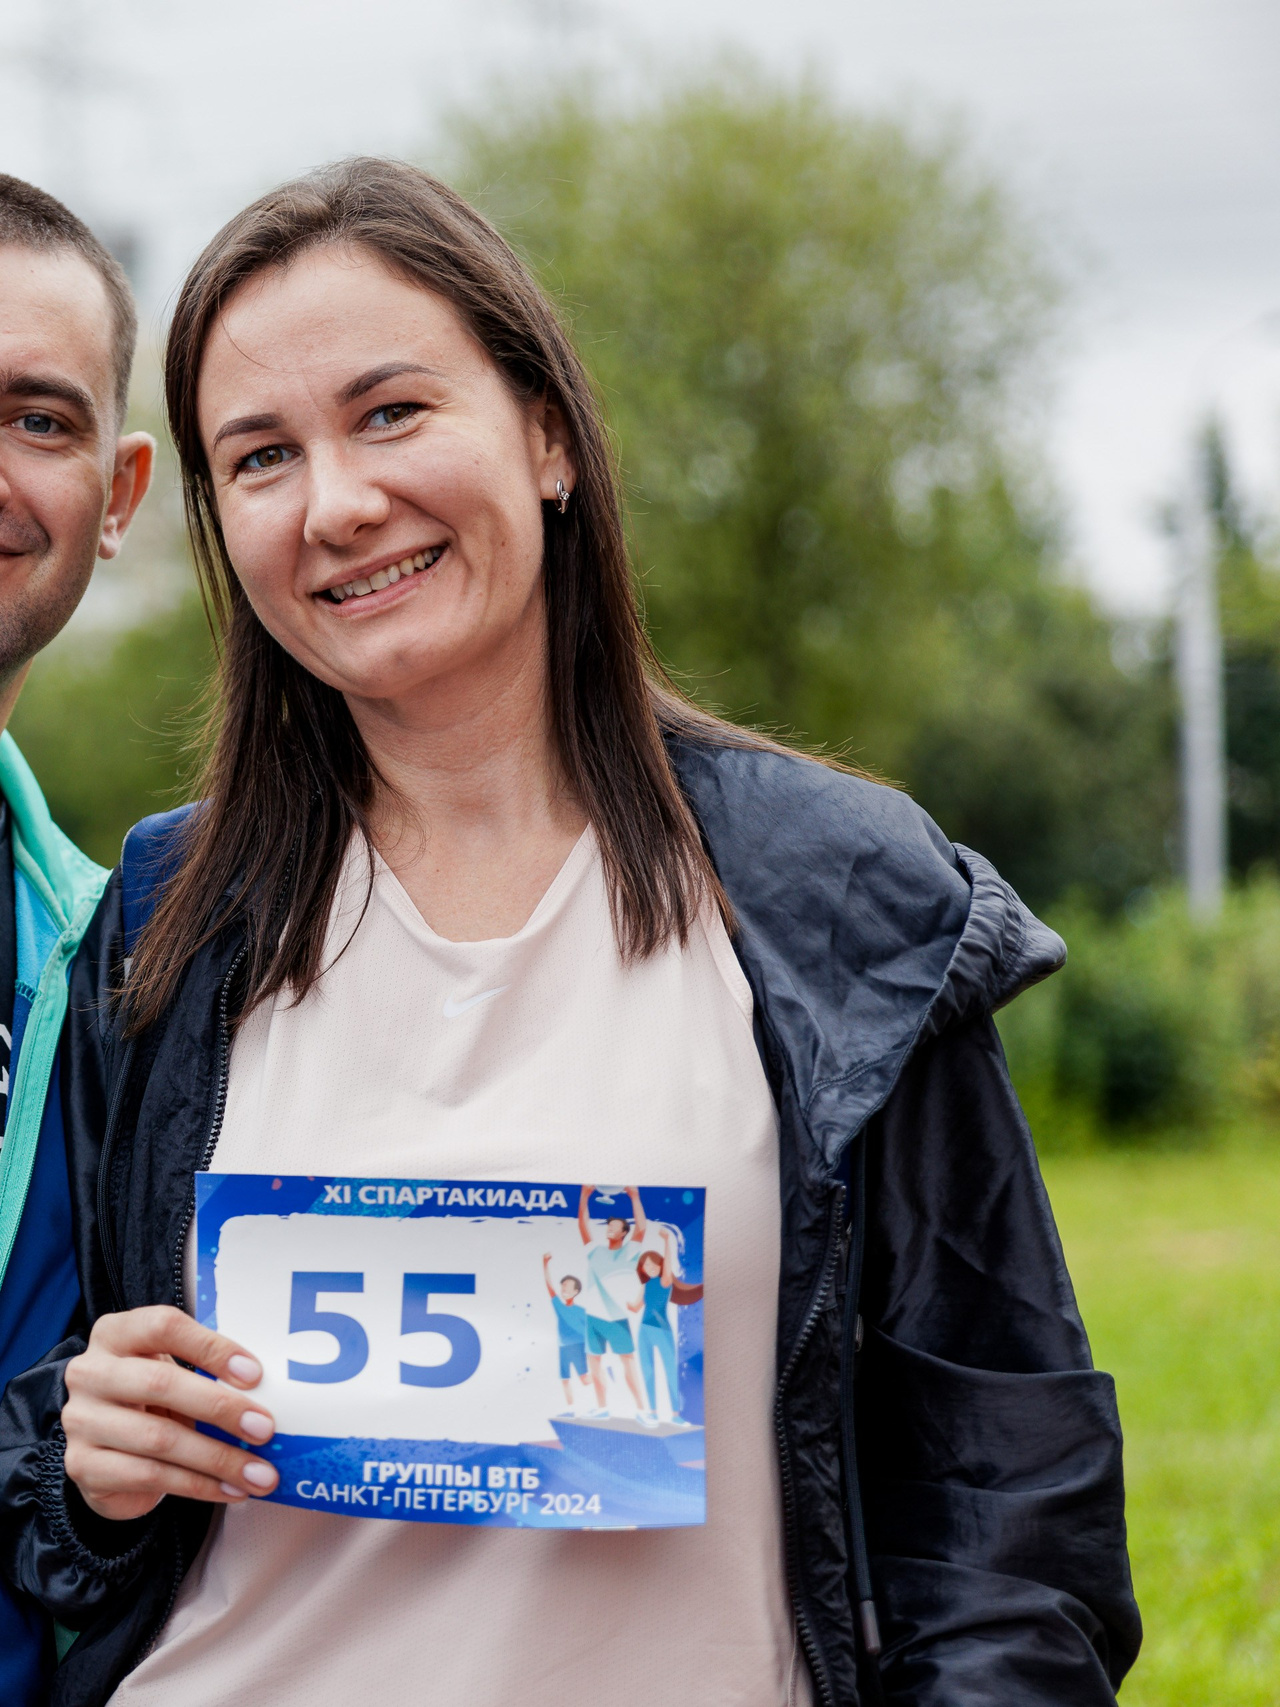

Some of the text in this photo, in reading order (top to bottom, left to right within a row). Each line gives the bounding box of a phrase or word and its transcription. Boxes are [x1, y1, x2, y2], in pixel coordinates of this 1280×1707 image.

[323, 1184, 568, 1211] XI СПАРТАКИАДА
[287, 1271, 482, 1388] 55
[362, 1461, 540, 1490] ГРУППЫ ВТБ
[296, 1480, 601, 1515] САНКТ-ПЕТЕРБУРГ 2024
